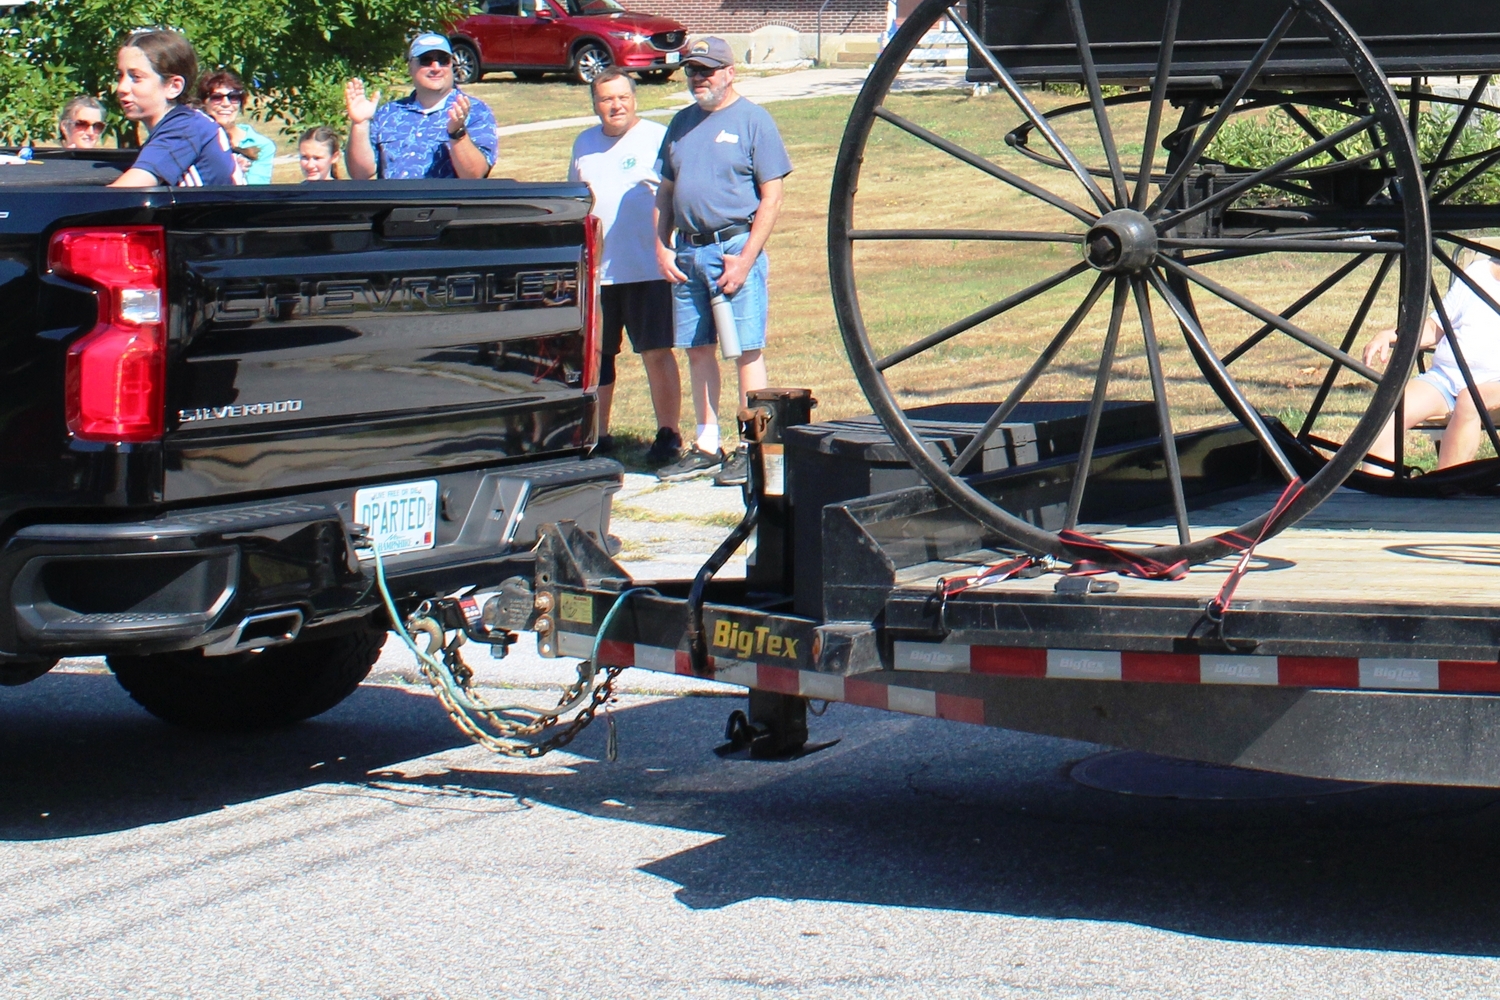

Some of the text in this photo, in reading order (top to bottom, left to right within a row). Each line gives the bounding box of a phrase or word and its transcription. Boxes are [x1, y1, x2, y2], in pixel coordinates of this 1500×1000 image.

[214, 269, 577, 321] CHEVROLET
[178, 399, 302, 423] SILVERADO
[362, 497, 426, 536] DPARTED
[713, 620, 800, 659] BigTex
